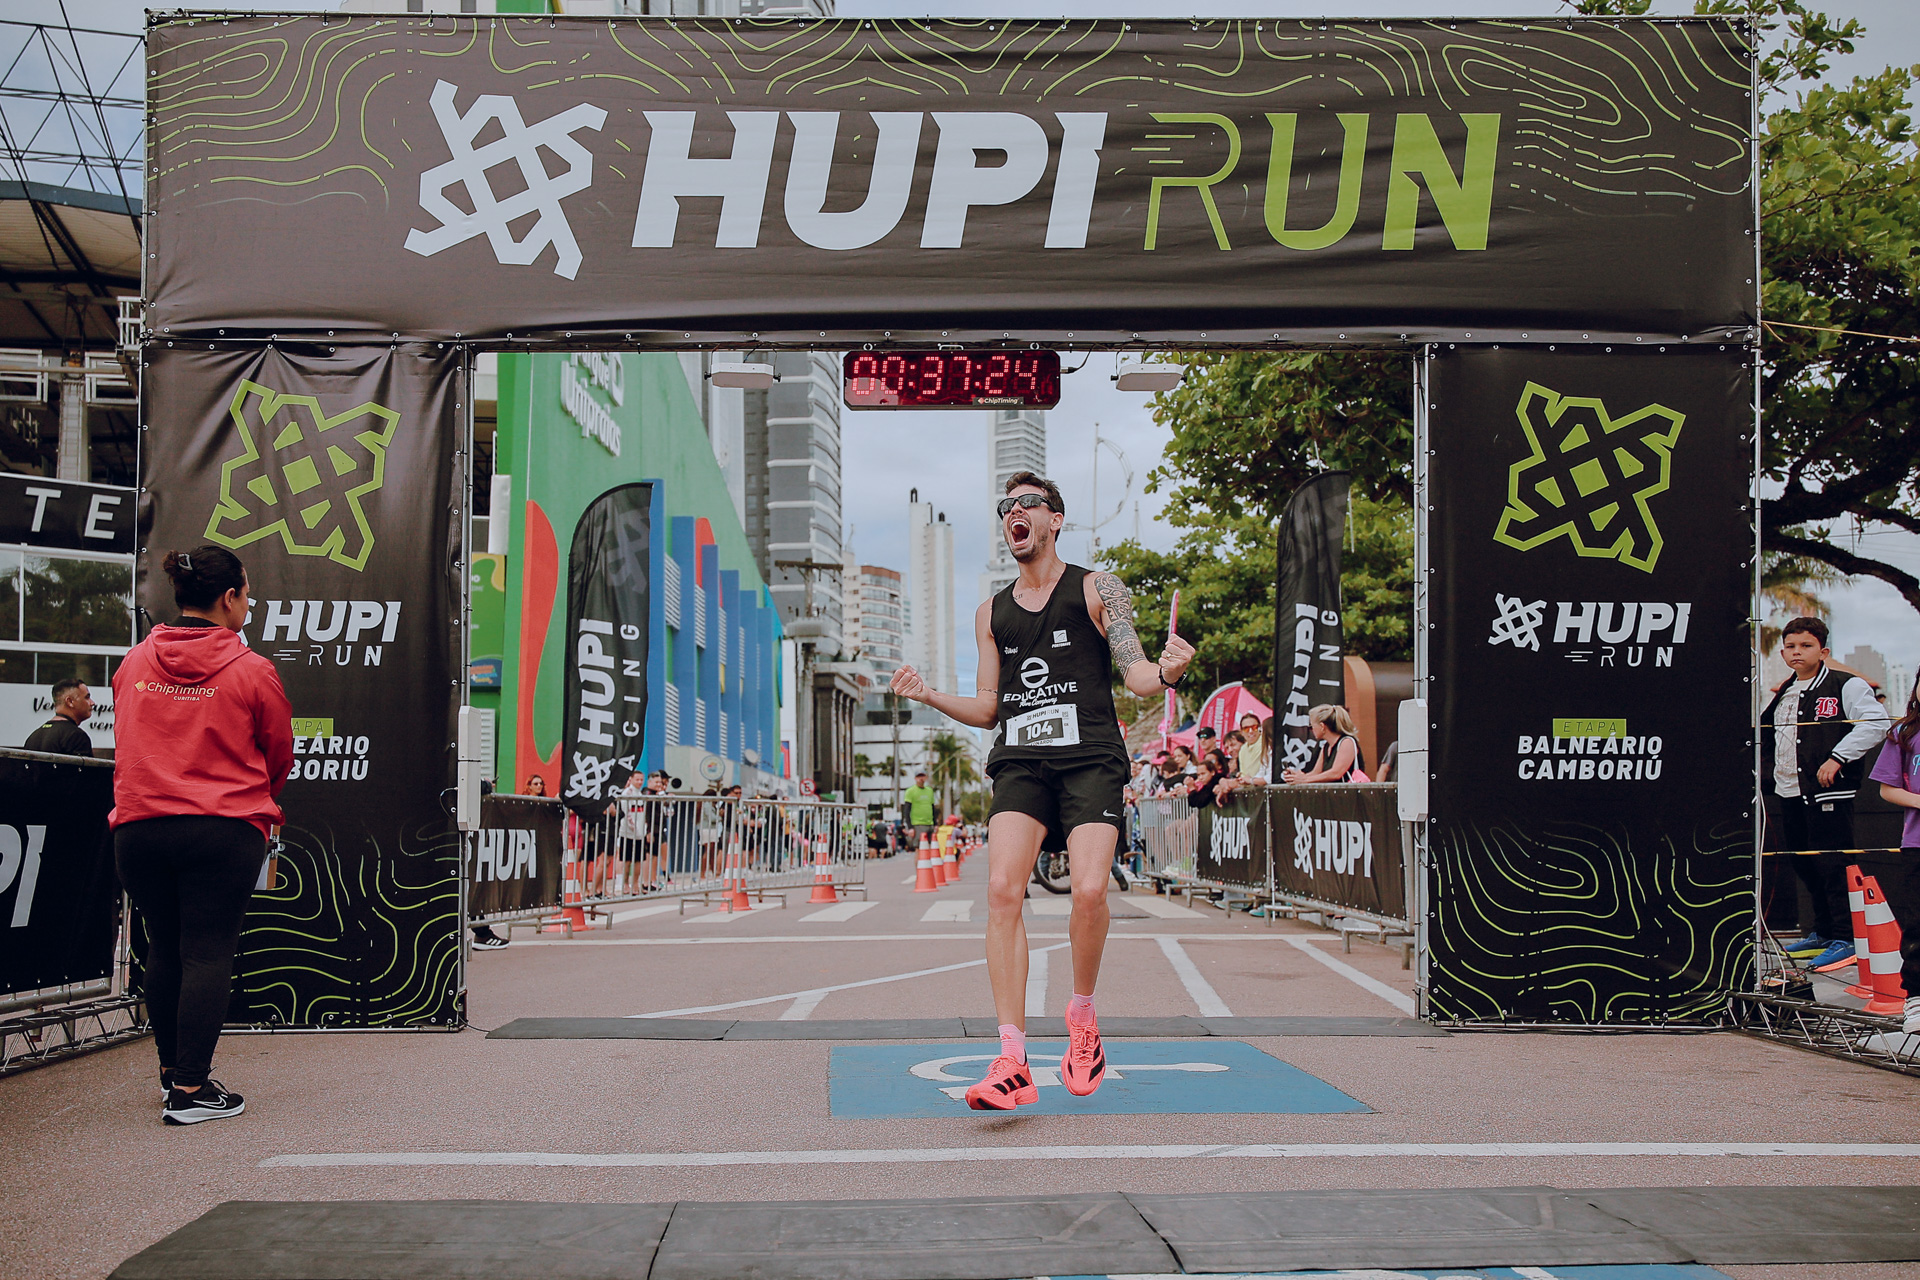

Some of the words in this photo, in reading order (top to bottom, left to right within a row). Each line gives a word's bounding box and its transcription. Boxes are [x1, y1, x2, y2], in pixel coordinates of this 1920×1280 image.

[631, 111, 1108, 250] HUPI
[1139, 112, 1501, 251] RUN
[984, 397, 1018, 405] ChipTiming
[262, 600, 402, 642] HUPI
[1553, 602, 1692, 643] HUPI
[308, 645, 382, 667] RUN
[1282, 603, 1318, 727] HUPI
[1600, 646, 1674, 667] RUN
[147, 682, 216, 698] ChipTiming
[577, 618, 616, 747] HUPI
[1003, 681, 1078, 703] EDUCATIVE
[607, 624, 641, 798] RACING
[1032, 710, 1047, 719] HUPI
[292, 721, 324, 732] APA
[1026, 720, 1053, 741] 104
[1564, 721, 1617, 733] ETAPA
[292, 732, 370, 754] EÁRIO
[1517, 732, 1663, 755] BALNEÁRIO
[286, 755, 369, 781] BORIÚ
[1518, 755, 1662, 780] CAMBORIÚ
[475, 829, 537, 882] HUPI
[1314, 819, 1372, 878] HUPI
